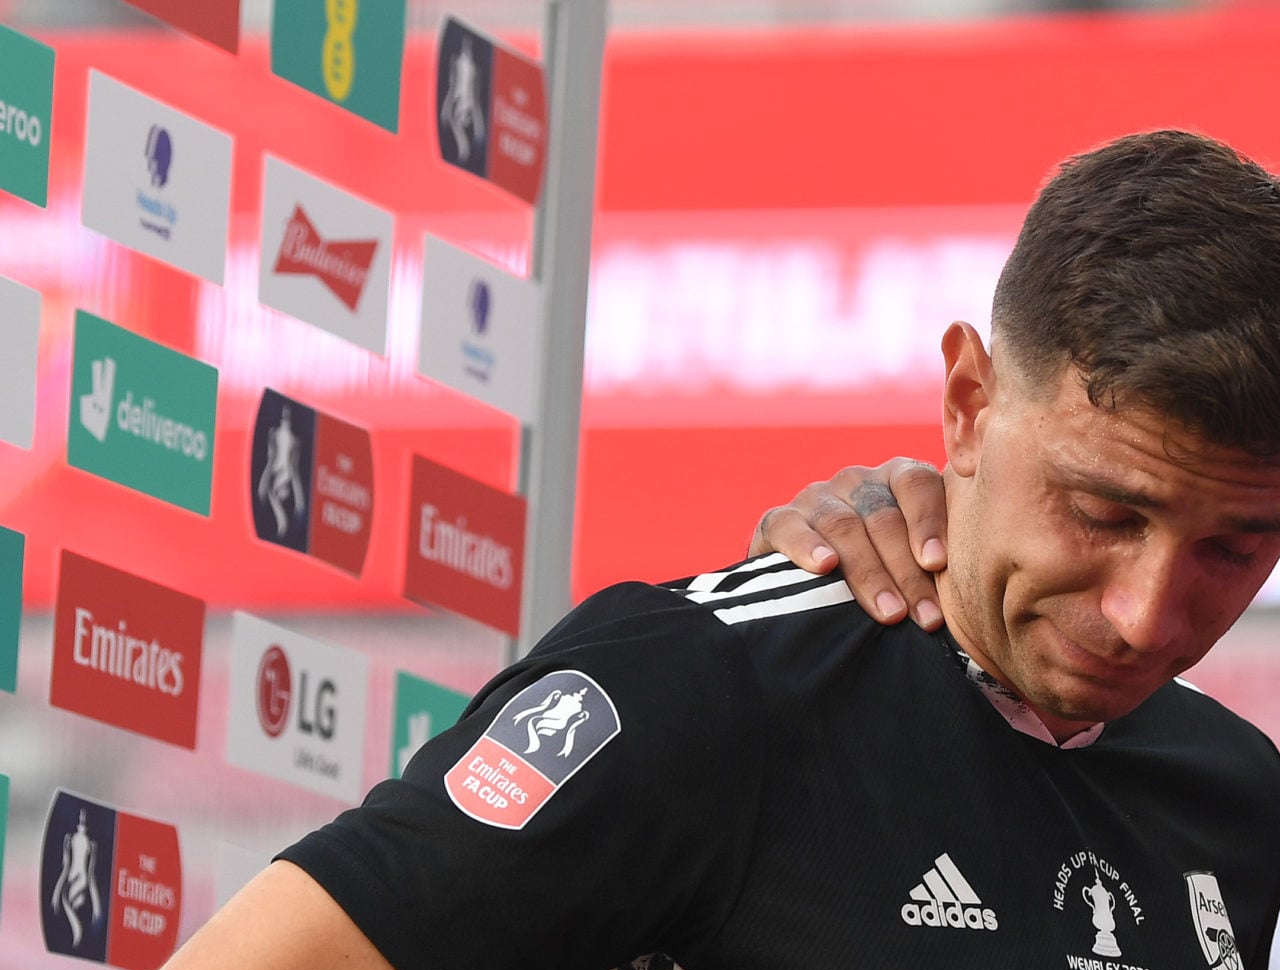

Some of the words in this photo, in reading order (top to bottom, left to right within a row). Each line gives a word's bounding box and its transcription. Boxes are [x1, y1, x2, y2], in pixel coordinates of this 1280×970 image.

[117, 392, 208, 461] deliveroo
[418, 503, 513, 590] Emirates
[73, 607, 185, 697] Emirates
[296, 668, 337, 741] LG
[467, 755, 530, 806] Emirates
[498, 757, 518, 776] THE
[478, 784, 509, 810] CUP
[117, 868, 176, 911] Emirates
[901, 900, 999, 931] adidas
[1053, 863, 1072, 912] HEADS
[1070, 851, 1087, 869] UP
[1100, 858, 1120, 881] CUP
[1119, 881, 1145, 926] FINAL
